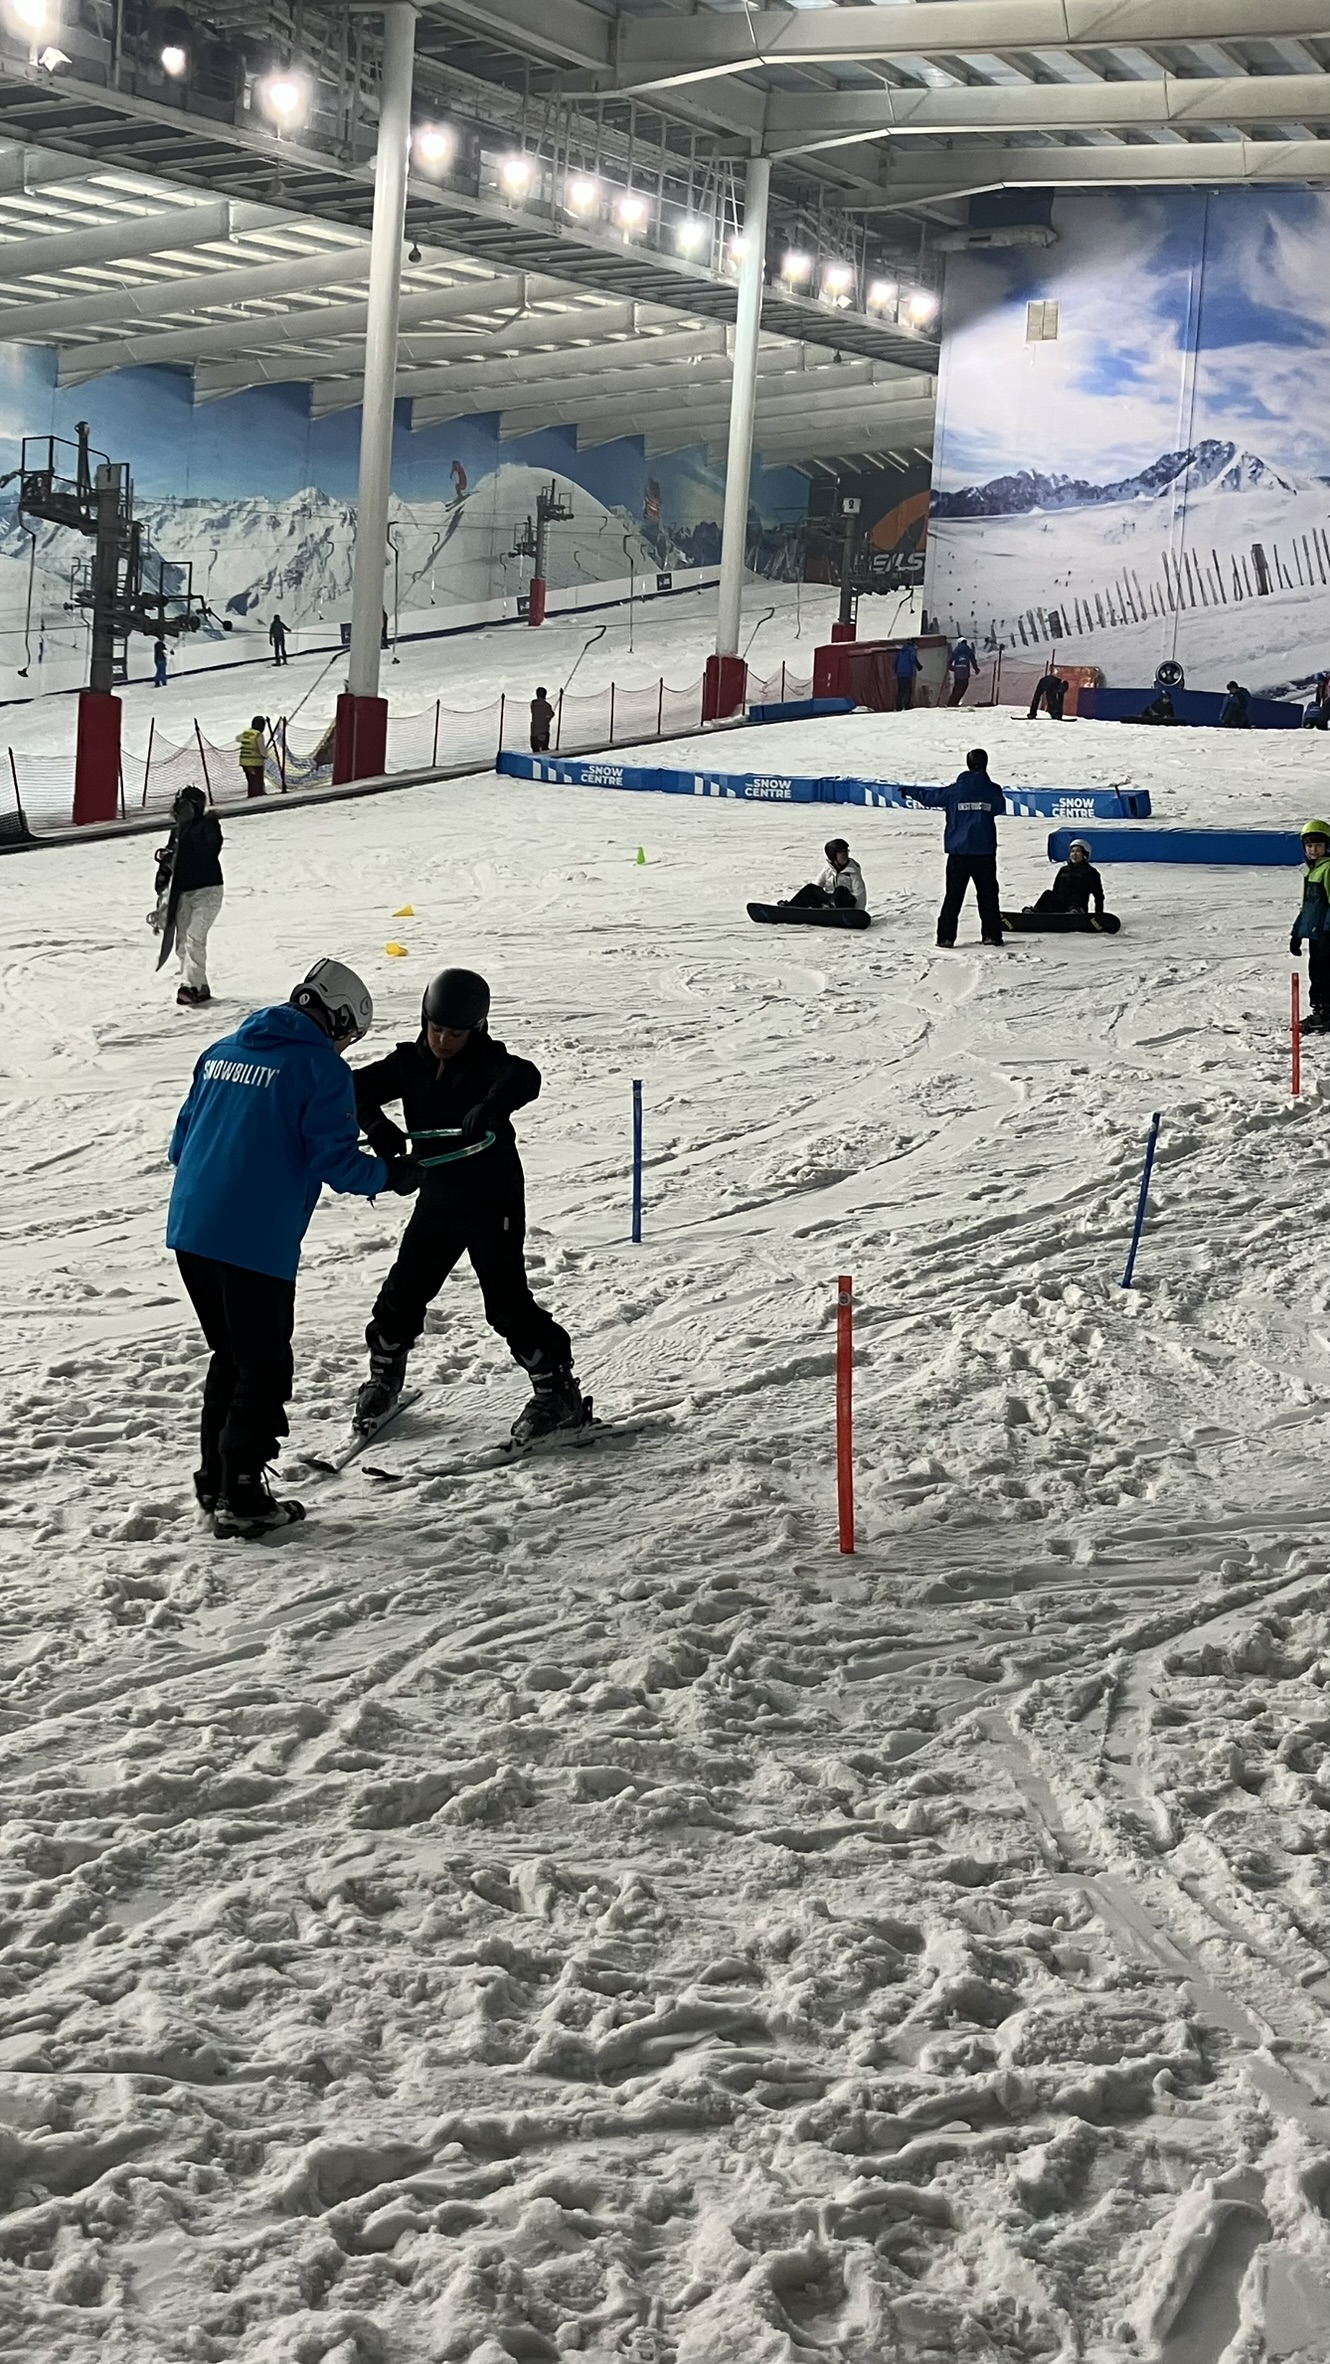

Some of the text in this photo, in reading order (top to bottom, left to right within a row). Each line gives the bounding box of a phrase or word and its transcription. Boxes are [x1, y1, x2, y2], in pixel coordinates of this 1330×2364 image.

[105, 466, 112, 483] 1
[588, 765, 624, 777] SNOW
[580, 774, 623, 786] CENTRE
[753, 778, 792, 789] SNOW
[744, 788, 792, 798] CENTRE
[1059, 797, 1095, 808] SNOW
[1051, 808, 1095, 818] CENTRE
[203, 1059, 275, 1088] SNOWBILITY
